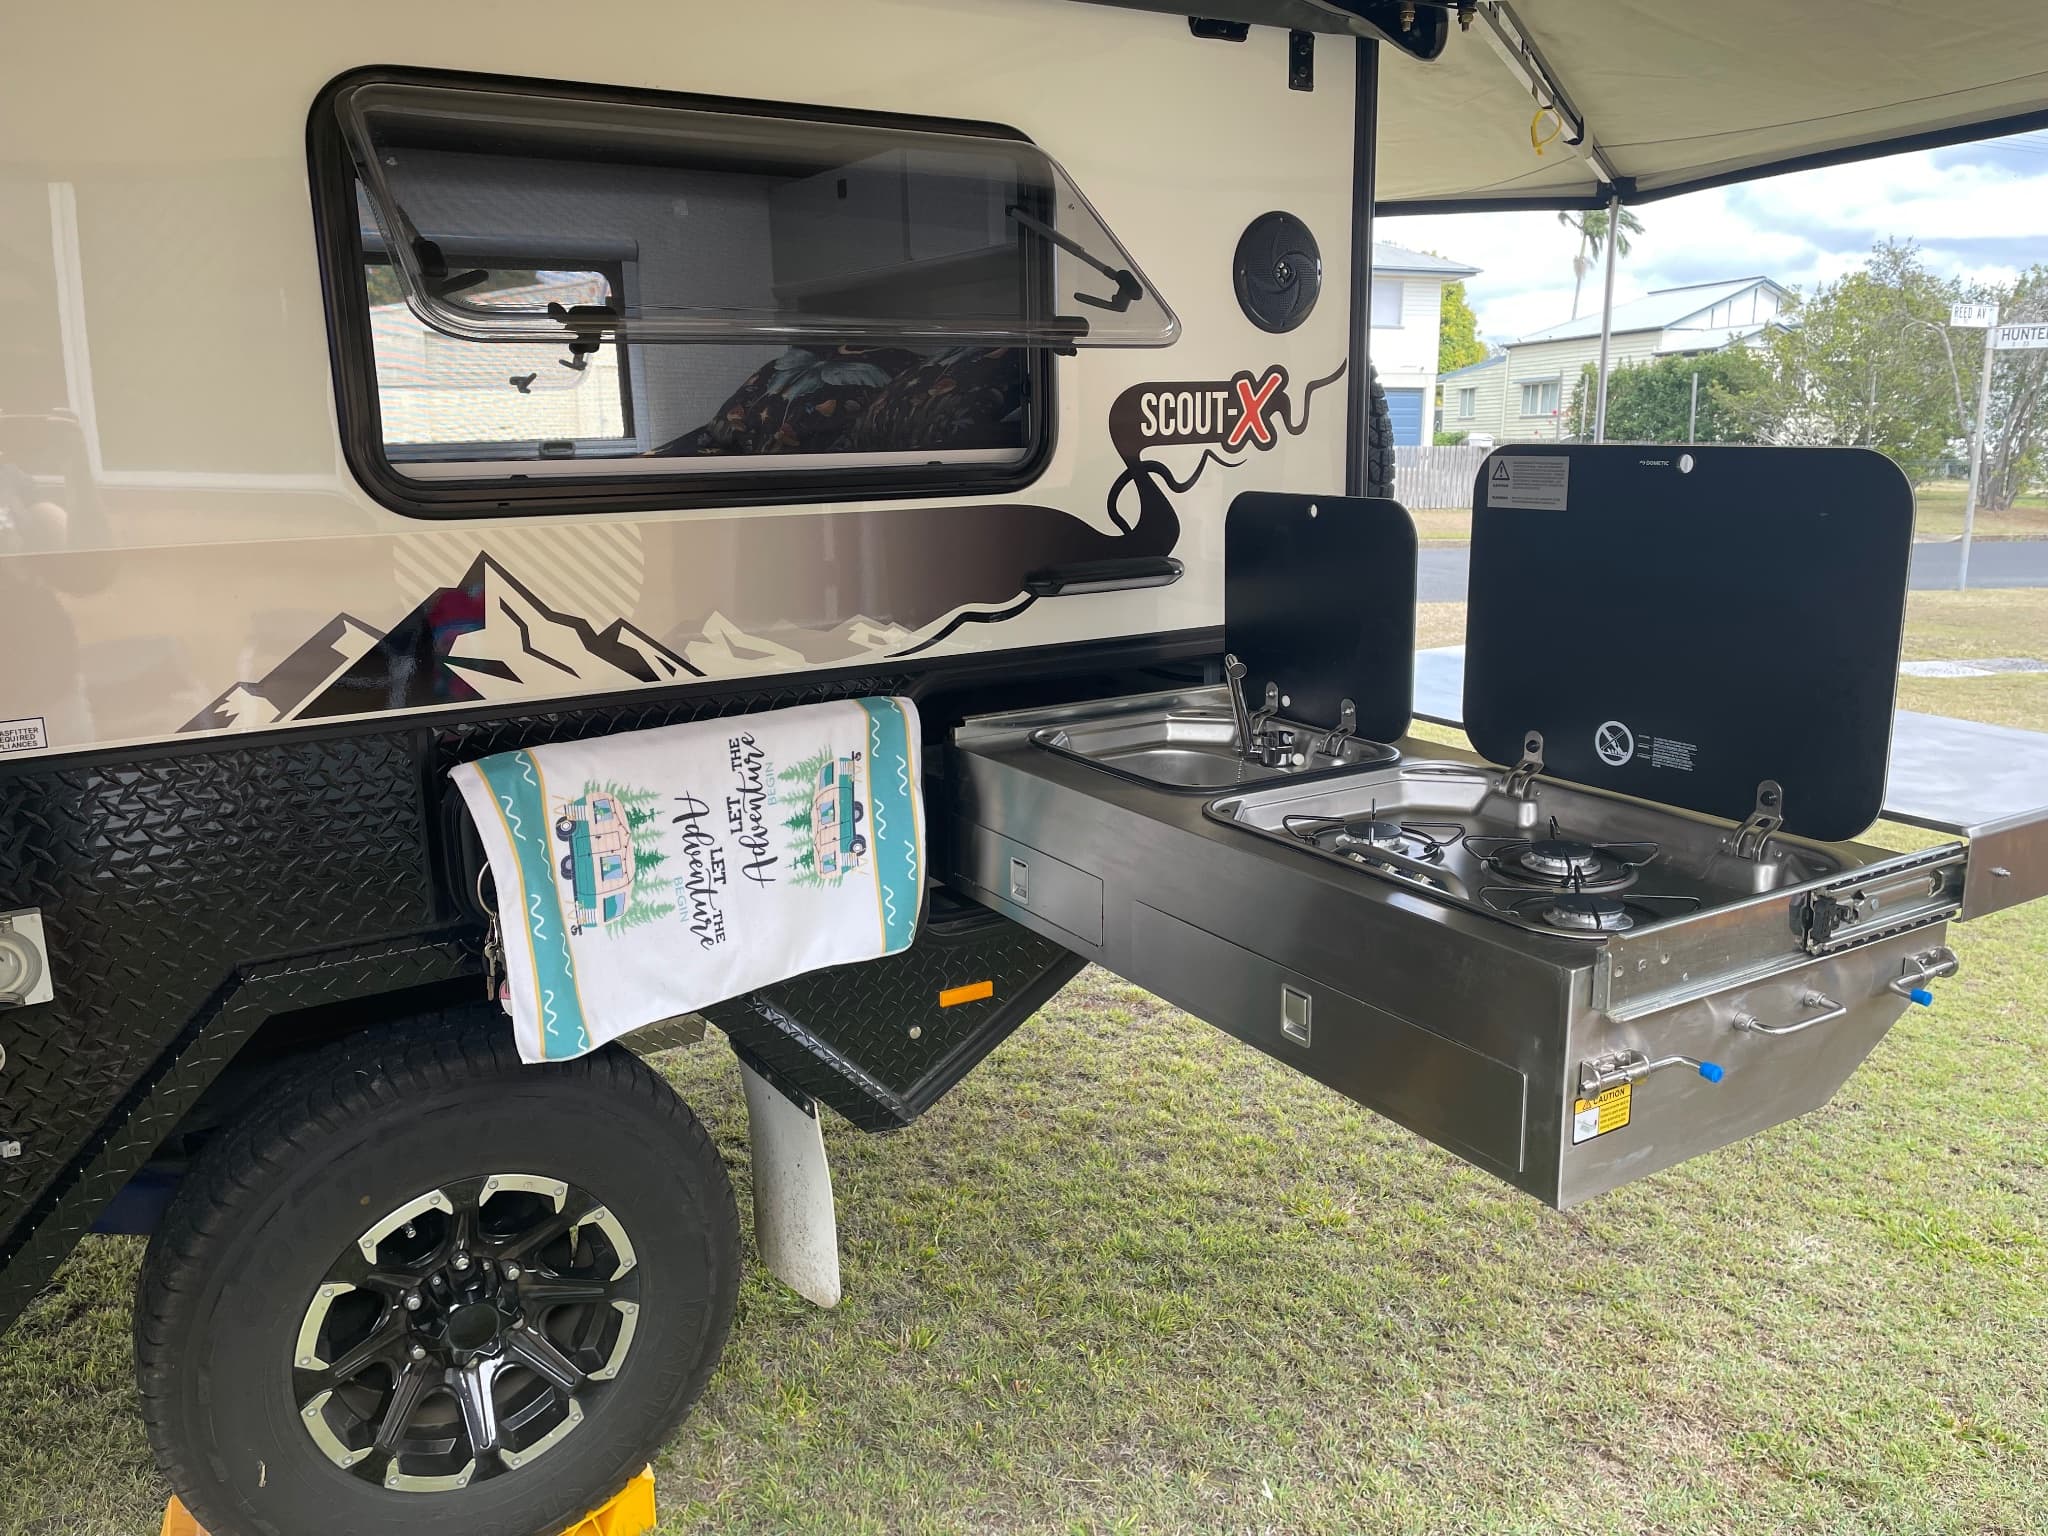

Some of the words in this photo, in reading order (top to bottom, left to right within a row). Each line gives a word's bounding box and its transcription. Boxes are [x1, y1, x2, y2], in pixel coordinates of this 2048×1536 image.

[1954, 306, 1973, 319] REED
[2001, 326, 2048, 341] HUNTE
[1141, 373, 1282, 445] SCOUT-X
[728, 738, 742, 772] THE
[765, 761, 777, 806] BEGIN
[727, 796, 743, 834] LET
[735, 731, 778, 888] Adventure
[672, 790, 718, 951] Adventure
[709, 847, 727, 885] LET
[673, 876, 690, 923] BEGIN
[712, 910, 726, 943] THE
